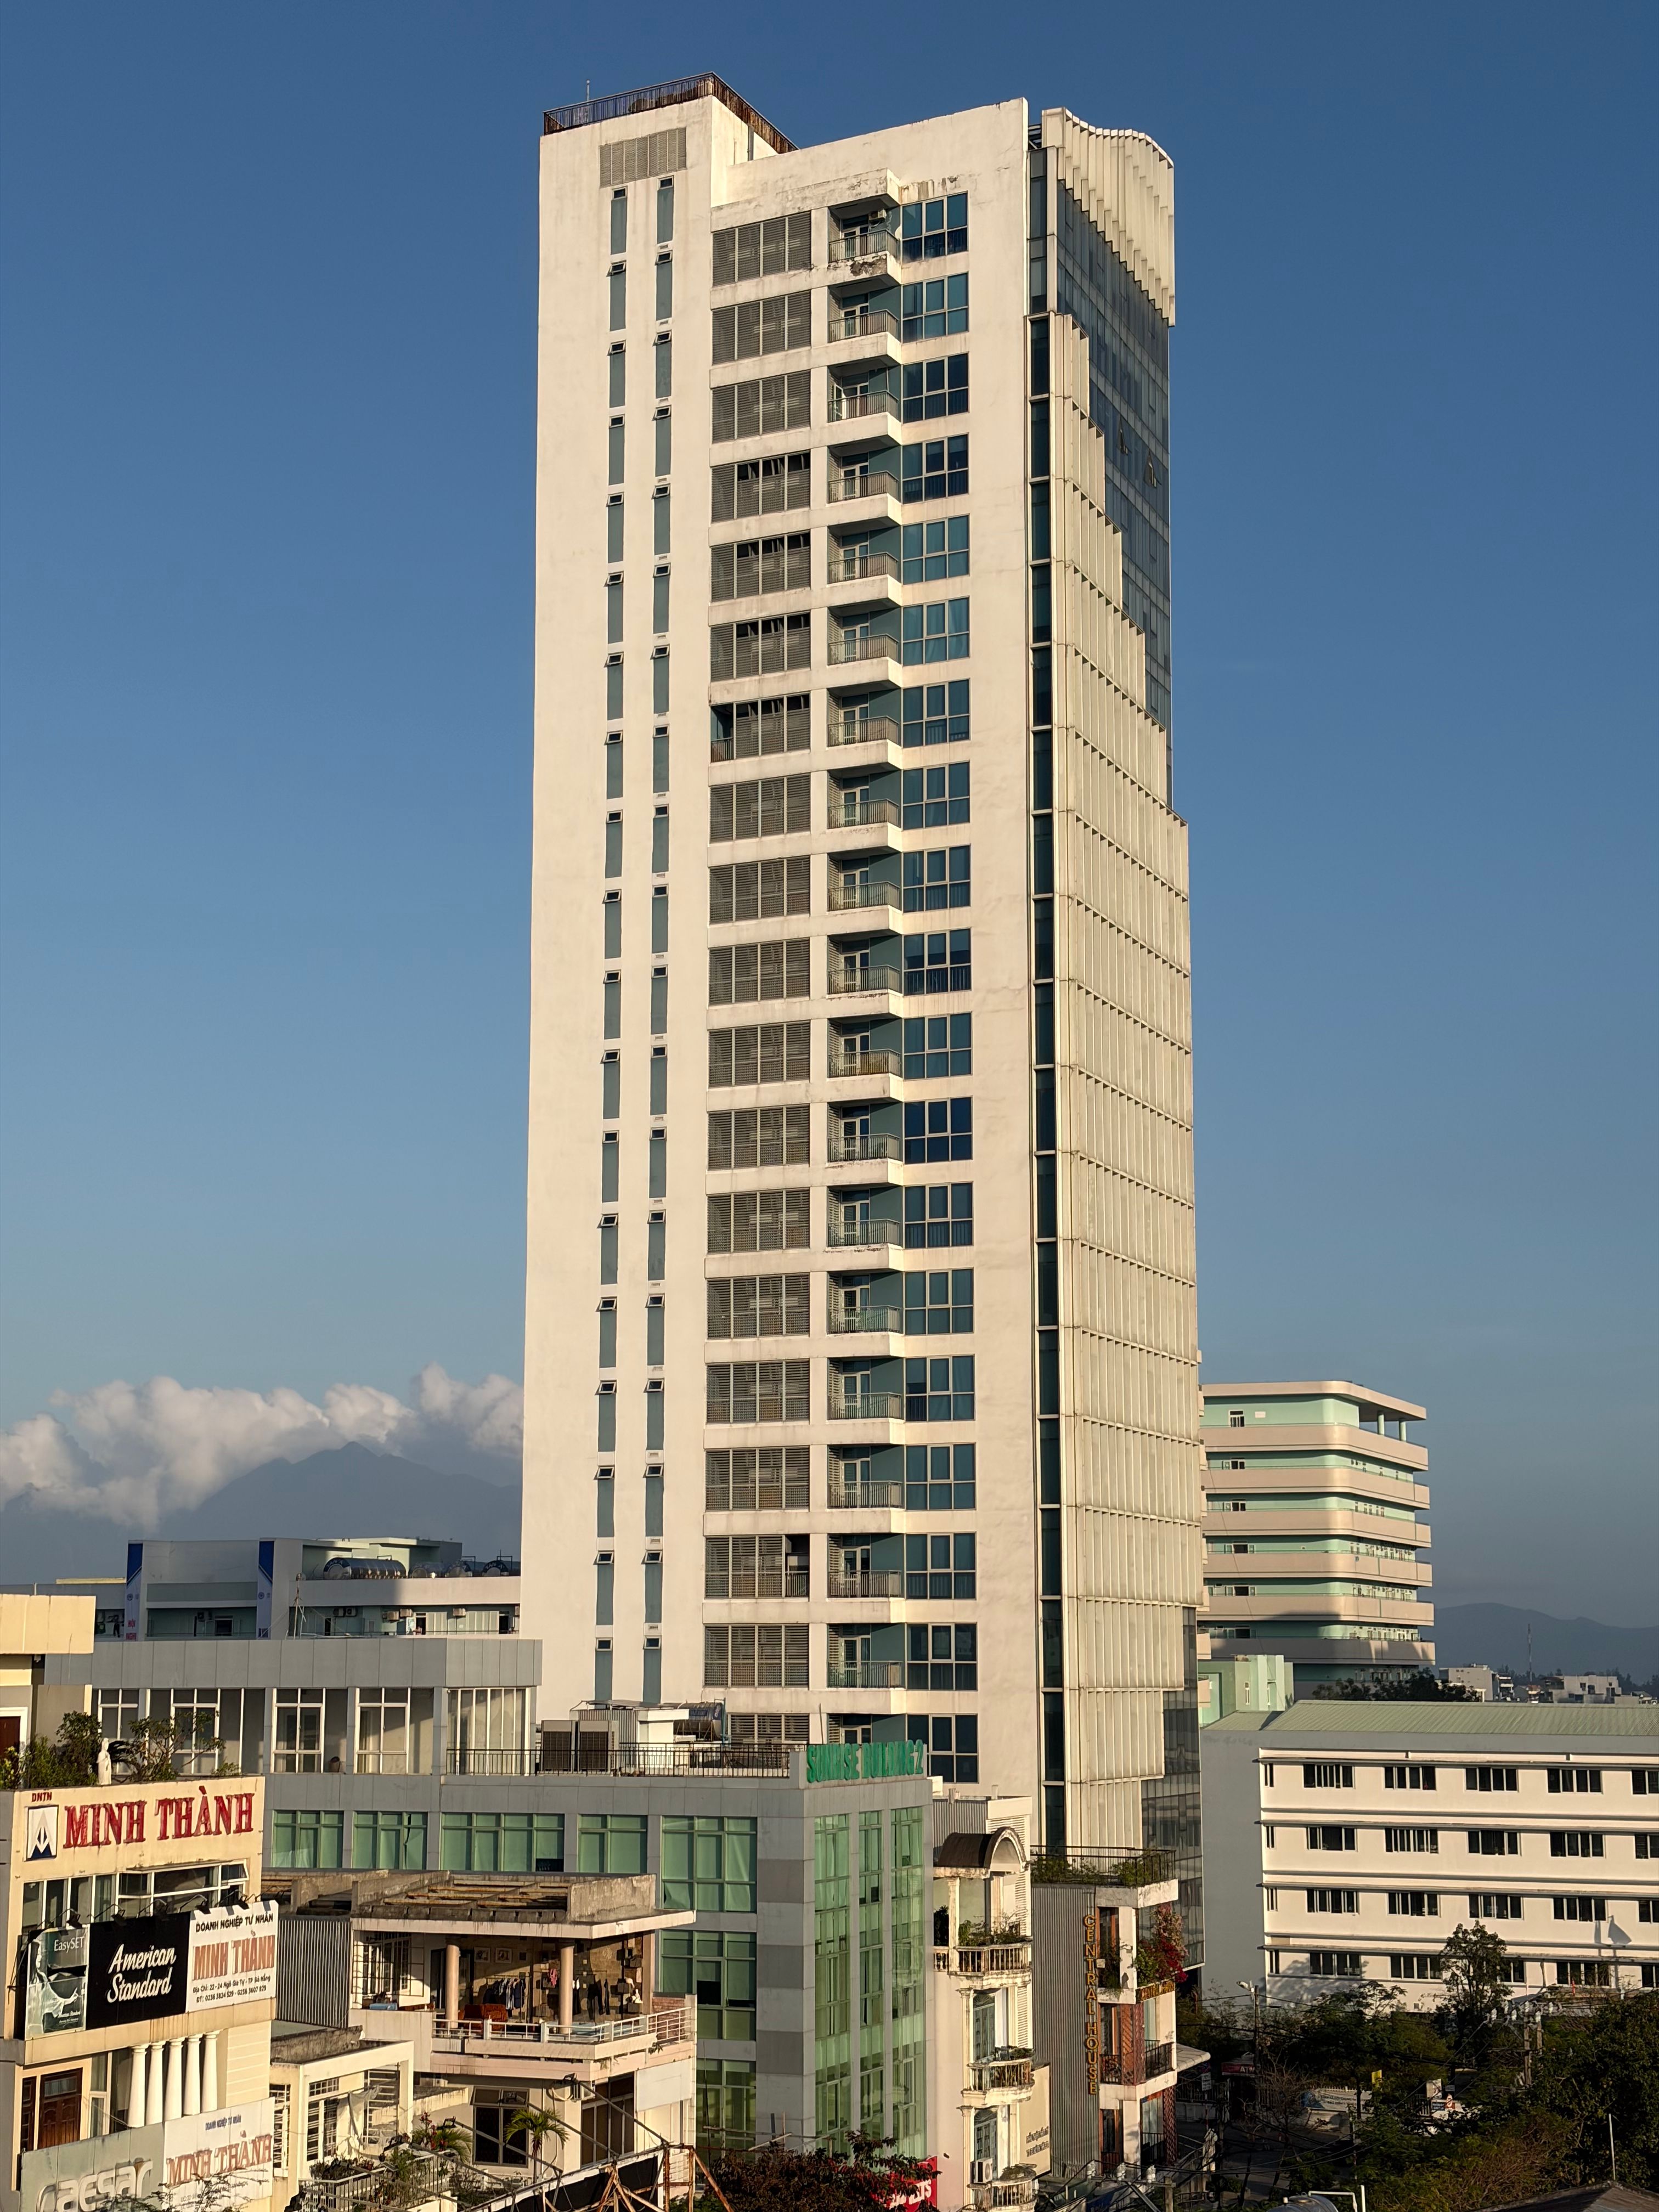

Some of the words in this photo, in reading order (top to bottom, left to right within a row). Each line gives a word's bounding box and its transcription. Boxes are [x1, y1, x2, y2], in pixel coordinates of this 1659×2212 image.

[807, 1742, 860, 1782] SUNRISE
[862, 1739, 914, 1778] BUILDING
[31, 1791, 52, 1802] DNTN
[63, 1799, 147, 1849] MINH
[154, 1785, 255, 1841] THÀNH
[54, 1936, 84, 1953] EasySET
[196, 1921, 218, 1932] DOANH
[220, 1915, 242, 1929] NGHIỆP
[245, 1914, 253, 1925] TƯ
[108, 1944, 176, 1974] American
[193, 1942, 229, 1981] MINH
[232, 1929, 275, 1974] THÀNH
[1084, 1914, 1097, 2015] CENTRAL
[106, 1967, 173, 2002] Standard
[1086, 2022, 1098, 2095] HOUSE
[166, 2148, 213, 2188] MINH
[214, 2130, 272, 2174] THÀNH
